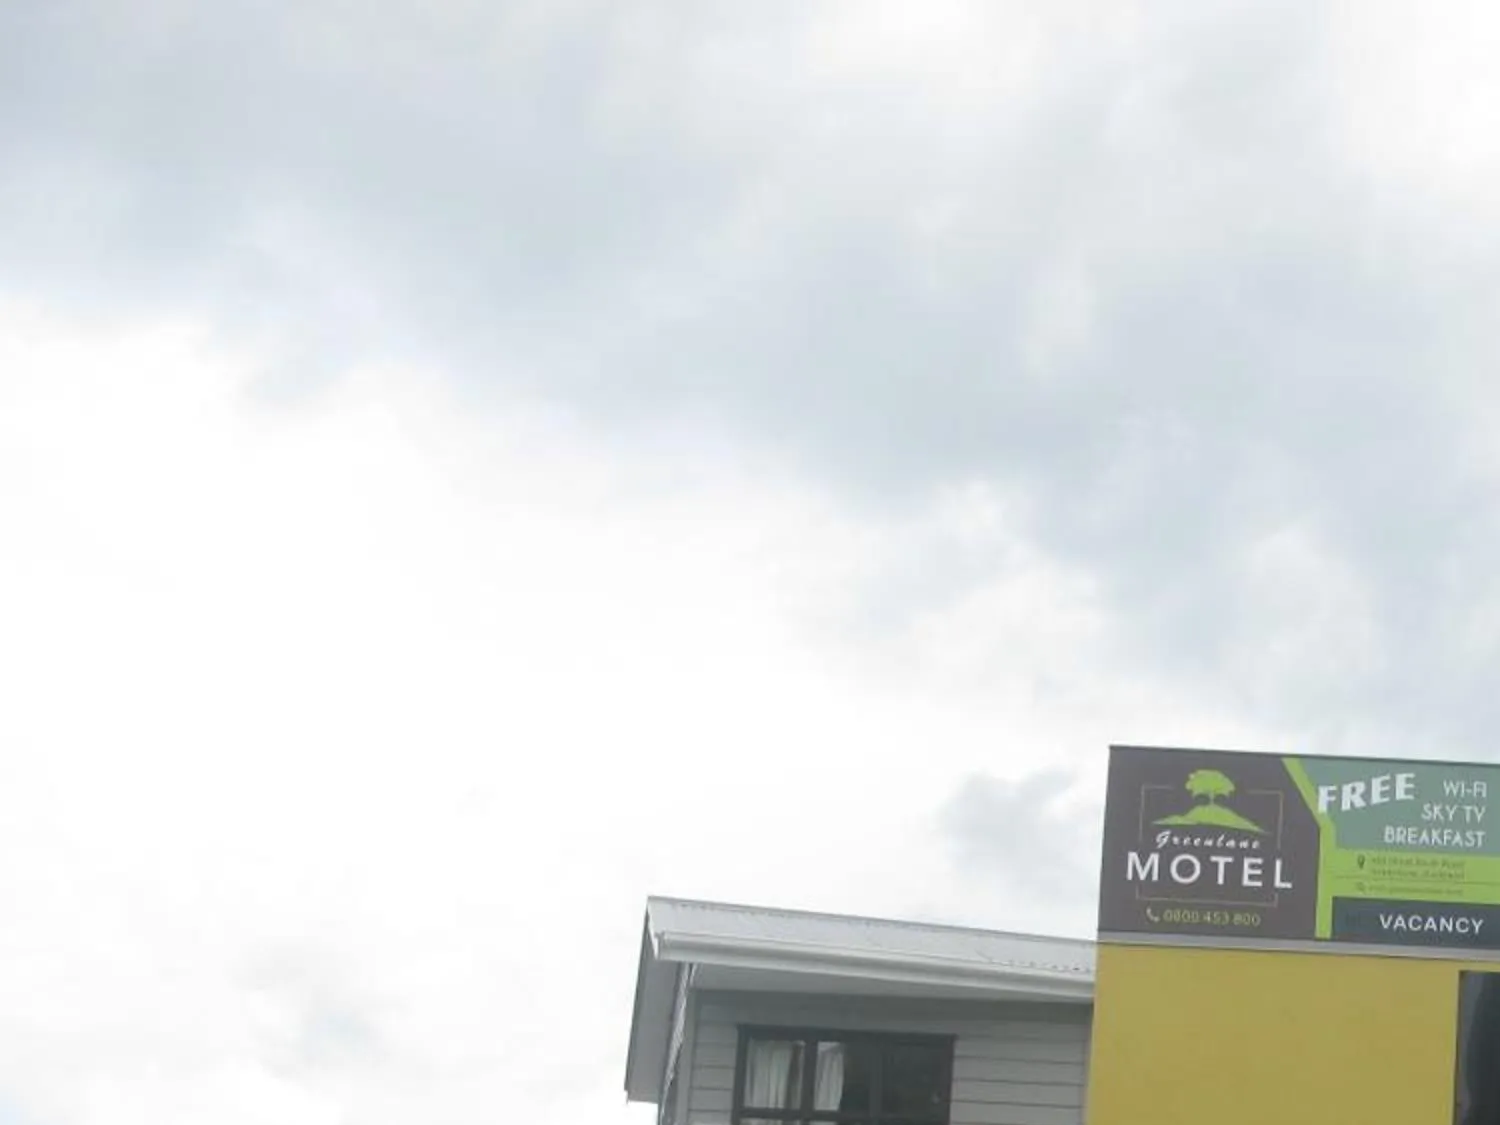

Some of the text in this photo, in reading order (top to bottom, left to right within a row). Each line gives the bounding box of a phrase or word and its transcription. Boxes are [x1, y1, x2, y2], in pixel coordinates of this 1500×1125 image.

[1317, 772, 1416, 814] FREE
[1420, 803, 1487, 824] SKY TV
[1155, 829, 1260, 849] Greenlane
[1383, 824, 1486, 848] BREAKFAST
[1125, 851, 1293, 889] MOTEL
[1162, 908, 1200, 923] 0800
[1379, 912, 1484, 936] VACANCY
